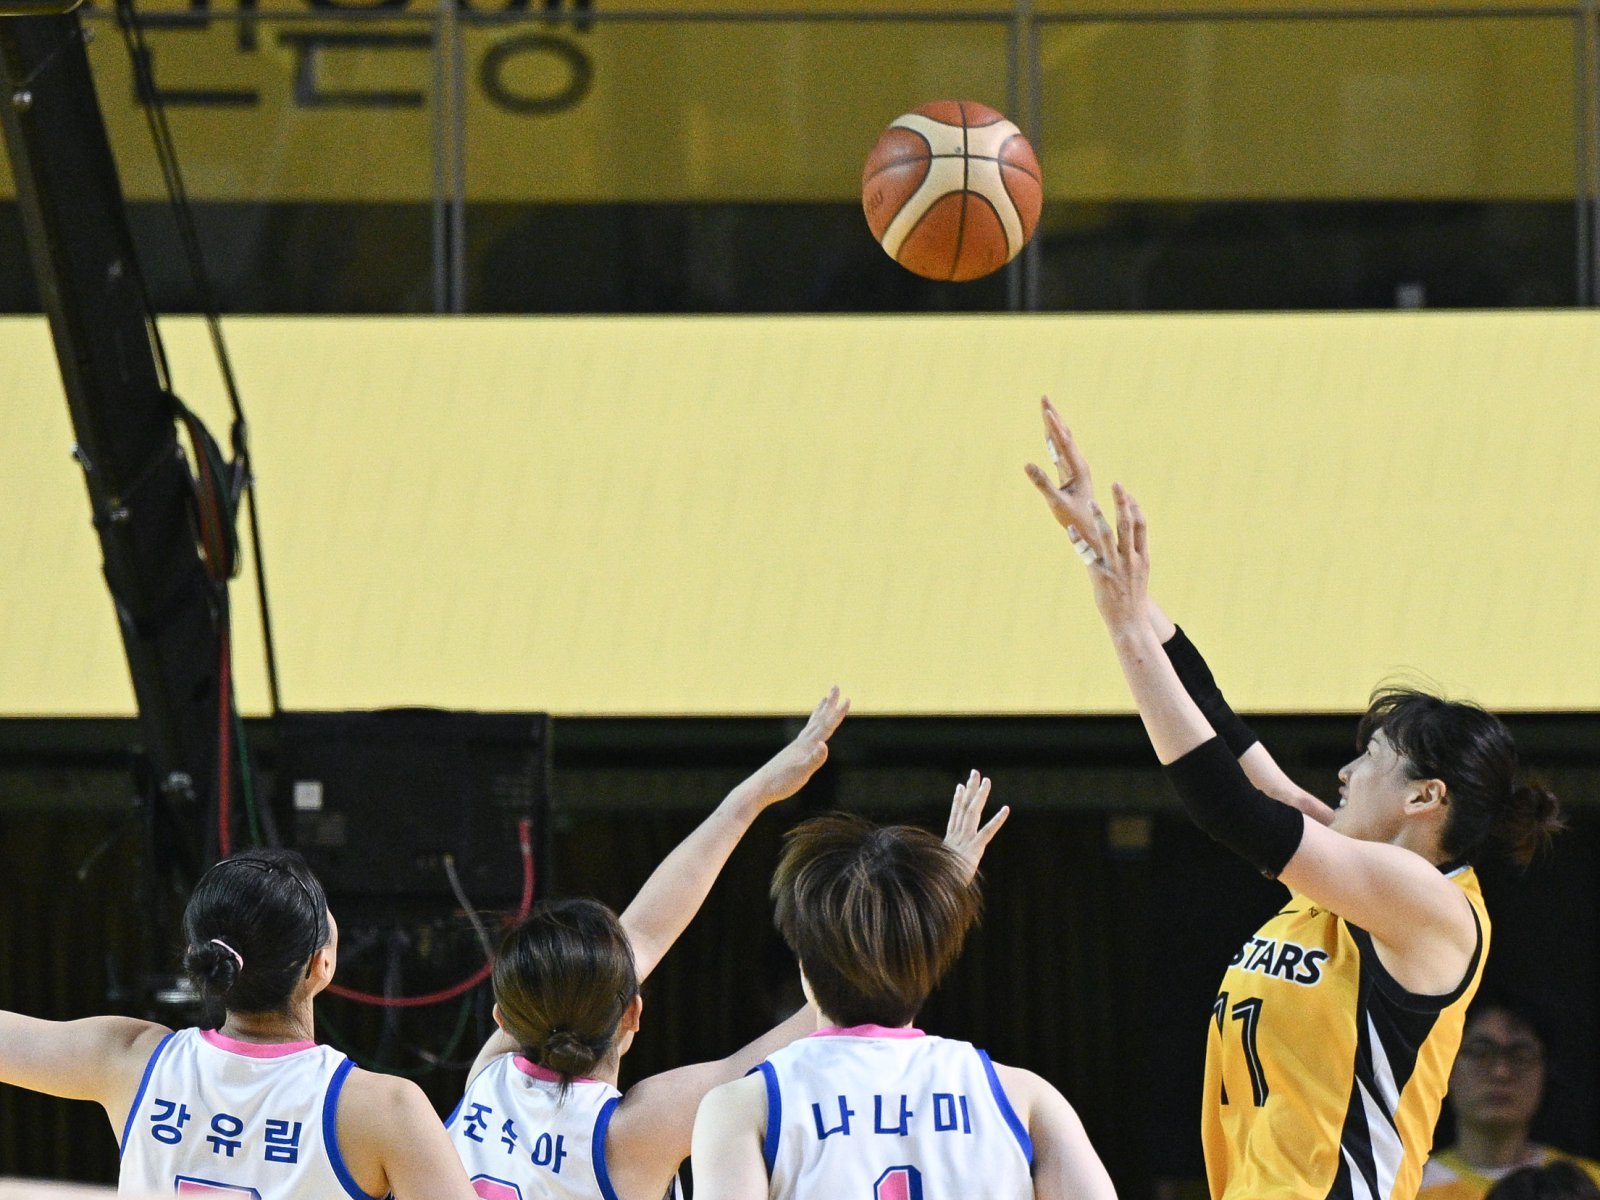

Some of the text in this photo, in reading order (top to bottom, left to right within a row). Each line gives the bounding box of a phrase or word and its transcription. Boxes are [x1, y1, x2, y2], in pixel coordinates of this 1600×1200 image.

[150, 1098, 302, 1164] 강유림
[463, 1102, 567, 1174] 조수아
[812, 1092, 972, 1141] 나나미
